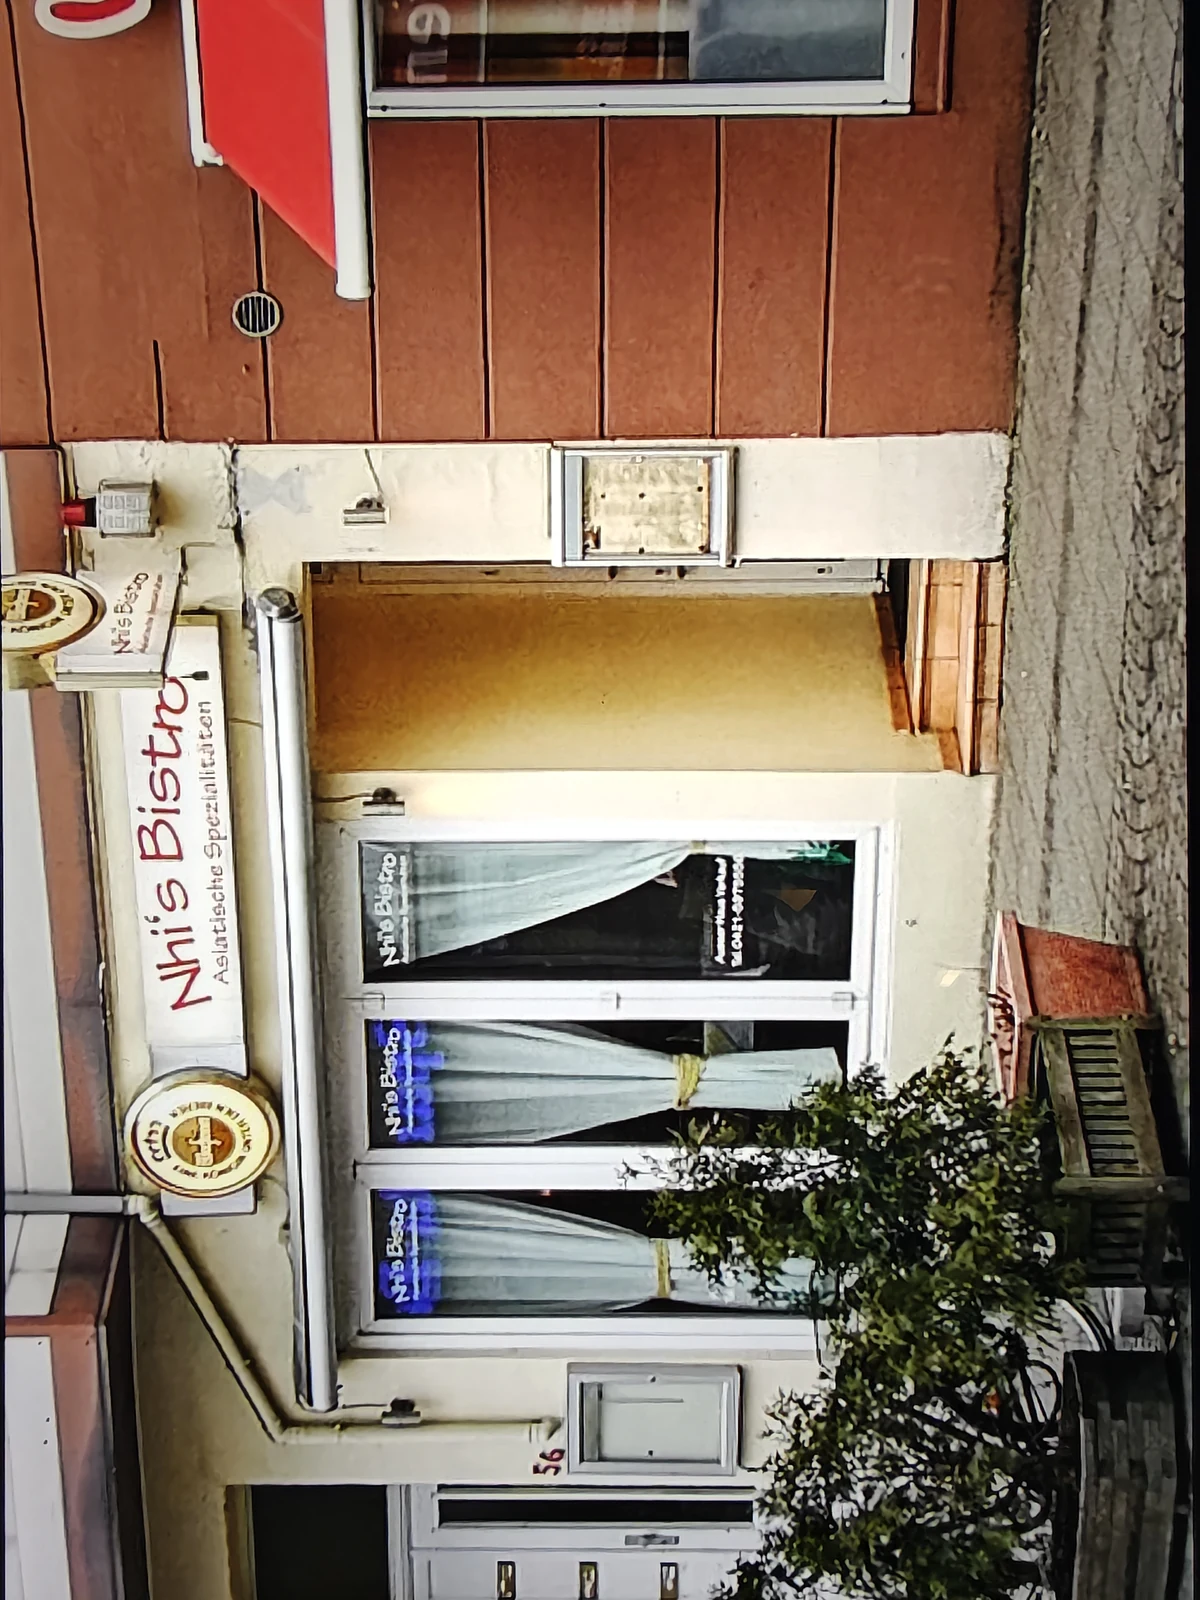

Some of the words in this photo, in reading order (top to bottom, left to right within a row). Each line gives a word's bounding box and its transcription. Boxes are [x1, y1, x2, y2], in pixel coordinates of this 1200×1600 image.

[136, 676, 190, 862] Bistro
[196, 700, 228, 860] Spezialitäten
[144, 878, 212, 1012] Nhi's
[208, 864, 230, 985] Asiatische
[532, 1448, 566, 1476] 56
